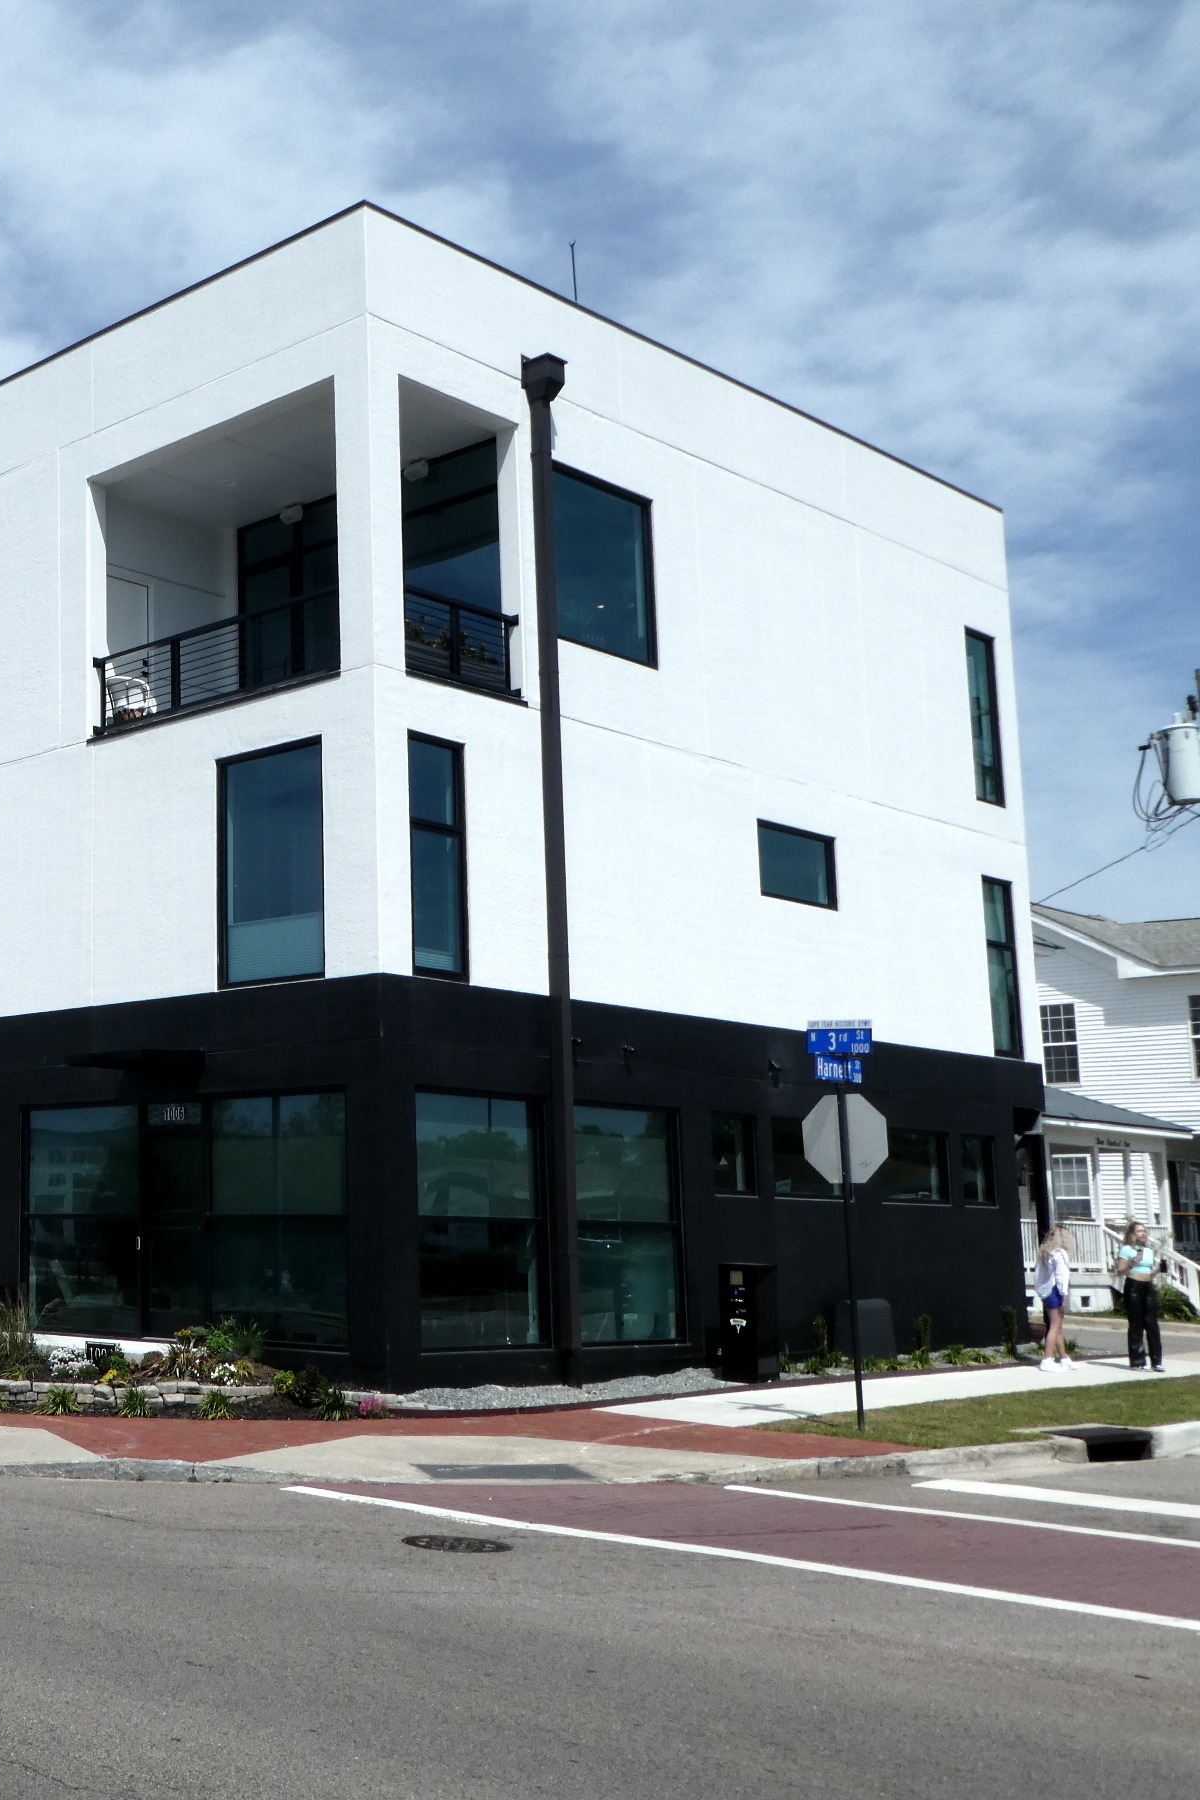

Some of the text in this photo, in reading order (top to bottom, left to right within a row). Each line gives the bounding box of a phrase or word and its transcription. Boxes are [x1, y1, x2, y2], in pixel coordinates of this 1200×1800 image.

[808, 1020, 820, 1028] CAPE
[821, 1020, 833, 1028] FEAR
[810, 1032, 816, 1042] N
[855, 1030, 864, 1040] St
[851, 1043, 870, 1053] 1000
[817, 1057, 852, 1079] Harnett
[164, 1106, 185, 1121] 1006
